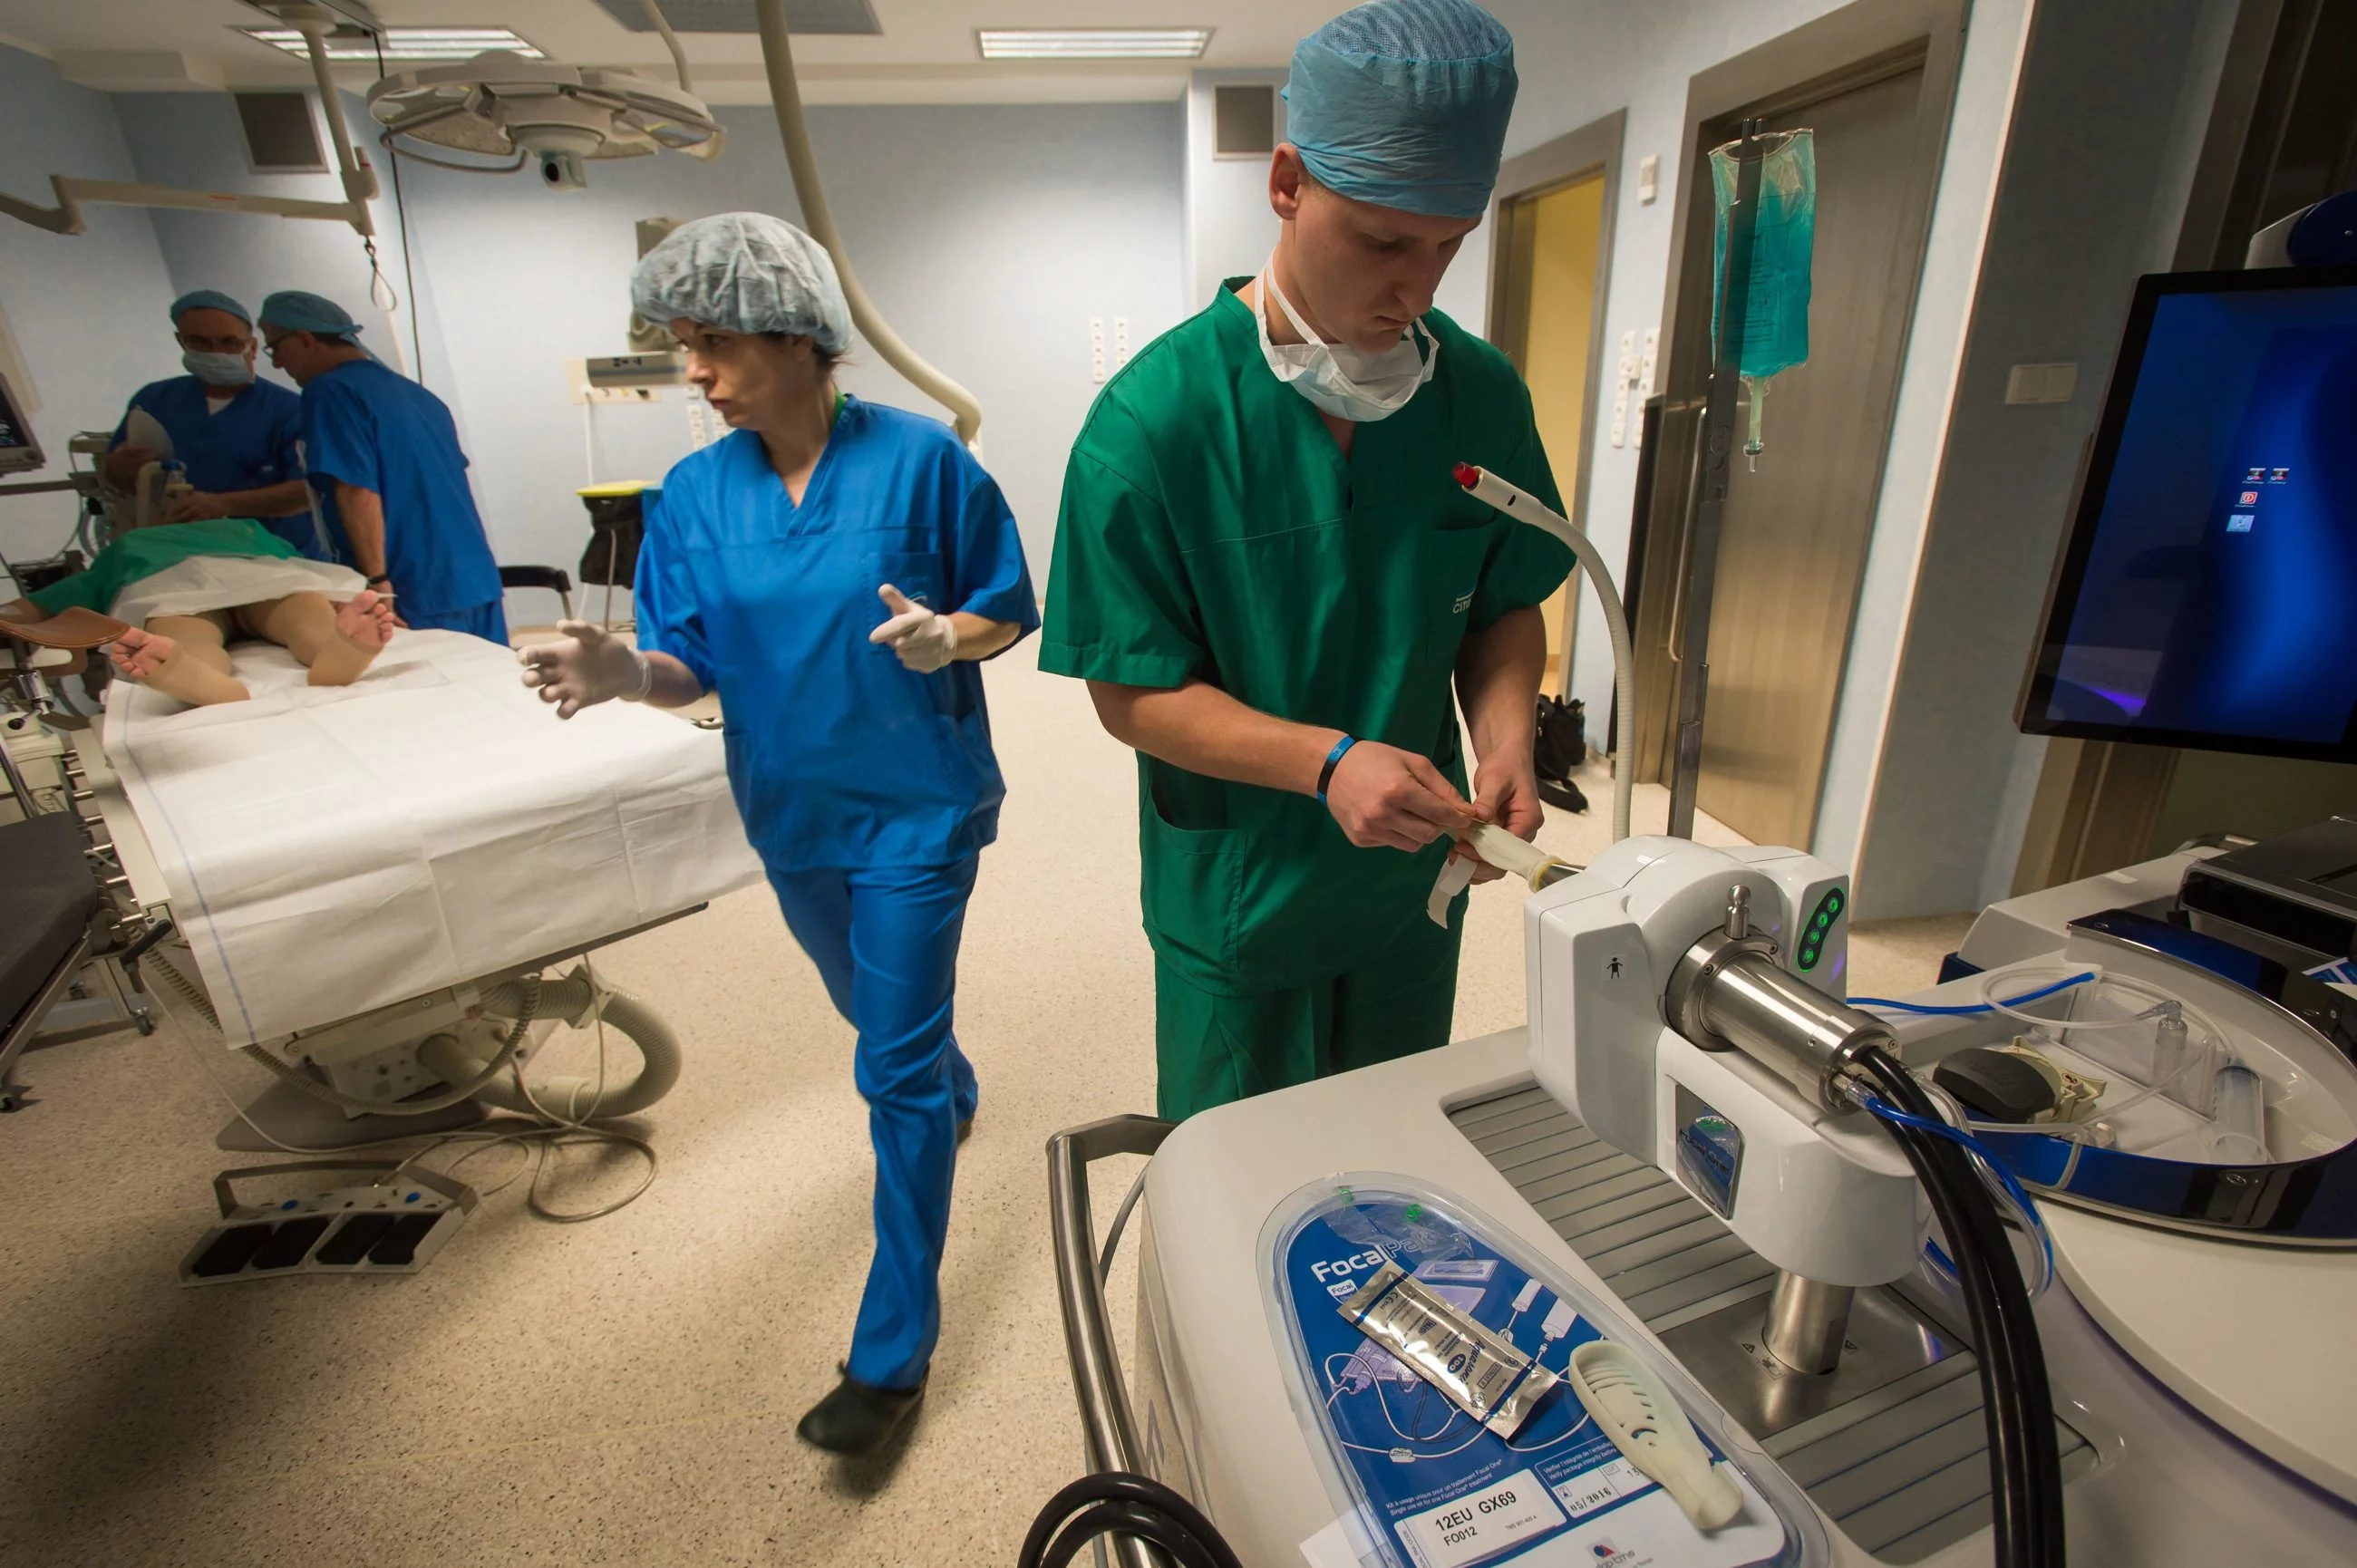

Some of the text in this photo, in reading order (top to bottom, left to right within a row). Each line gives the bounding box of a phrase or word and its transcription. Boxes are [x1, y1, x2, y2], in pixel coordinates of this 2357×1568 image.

[1331, 1282, 1353, 1294] Focal
[1450, 1355, 1464, 1371] 100
[1475, 1465, 1490, 1476] Focal
[1569, 1487, 1612, 1512] 05/2016
[1435, 1491, 1517, 1532] 12EU GX69
[1443, 1525, 1478, 1546] FO012
